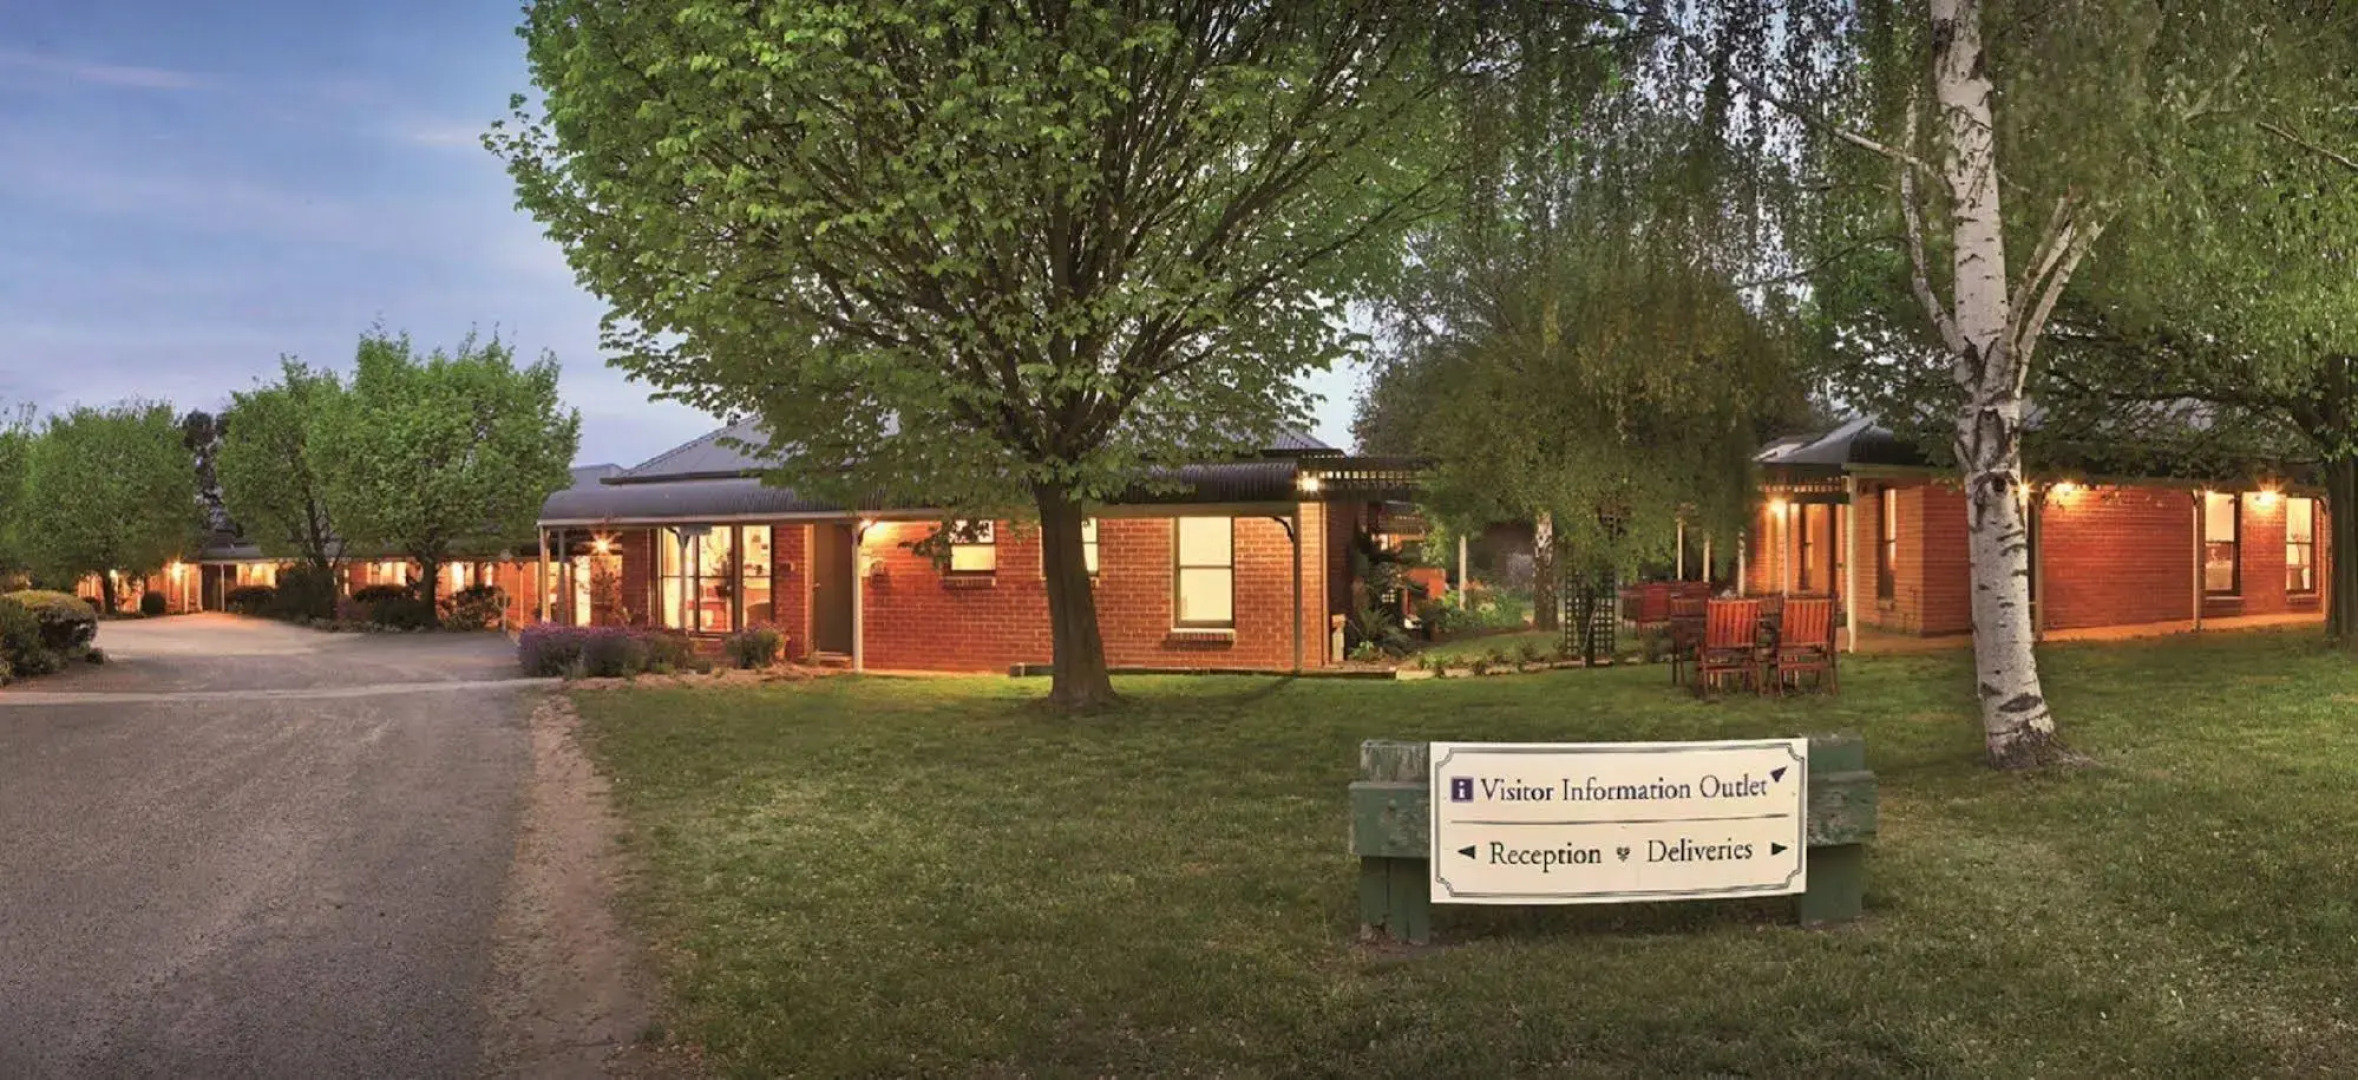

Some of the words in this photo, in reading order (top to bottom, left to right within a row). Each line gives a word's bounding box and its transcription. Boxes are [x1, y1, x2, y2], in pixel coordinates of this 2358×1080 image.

[1481, 778, 1554, 801] Visitor
[1562, 776, 1691, 801] Information
[1699, 773, 1767, 799] Outlet
[1489, 841, 1602, 873] Reception
[1648, 838, 1753, 863] Deliveries
